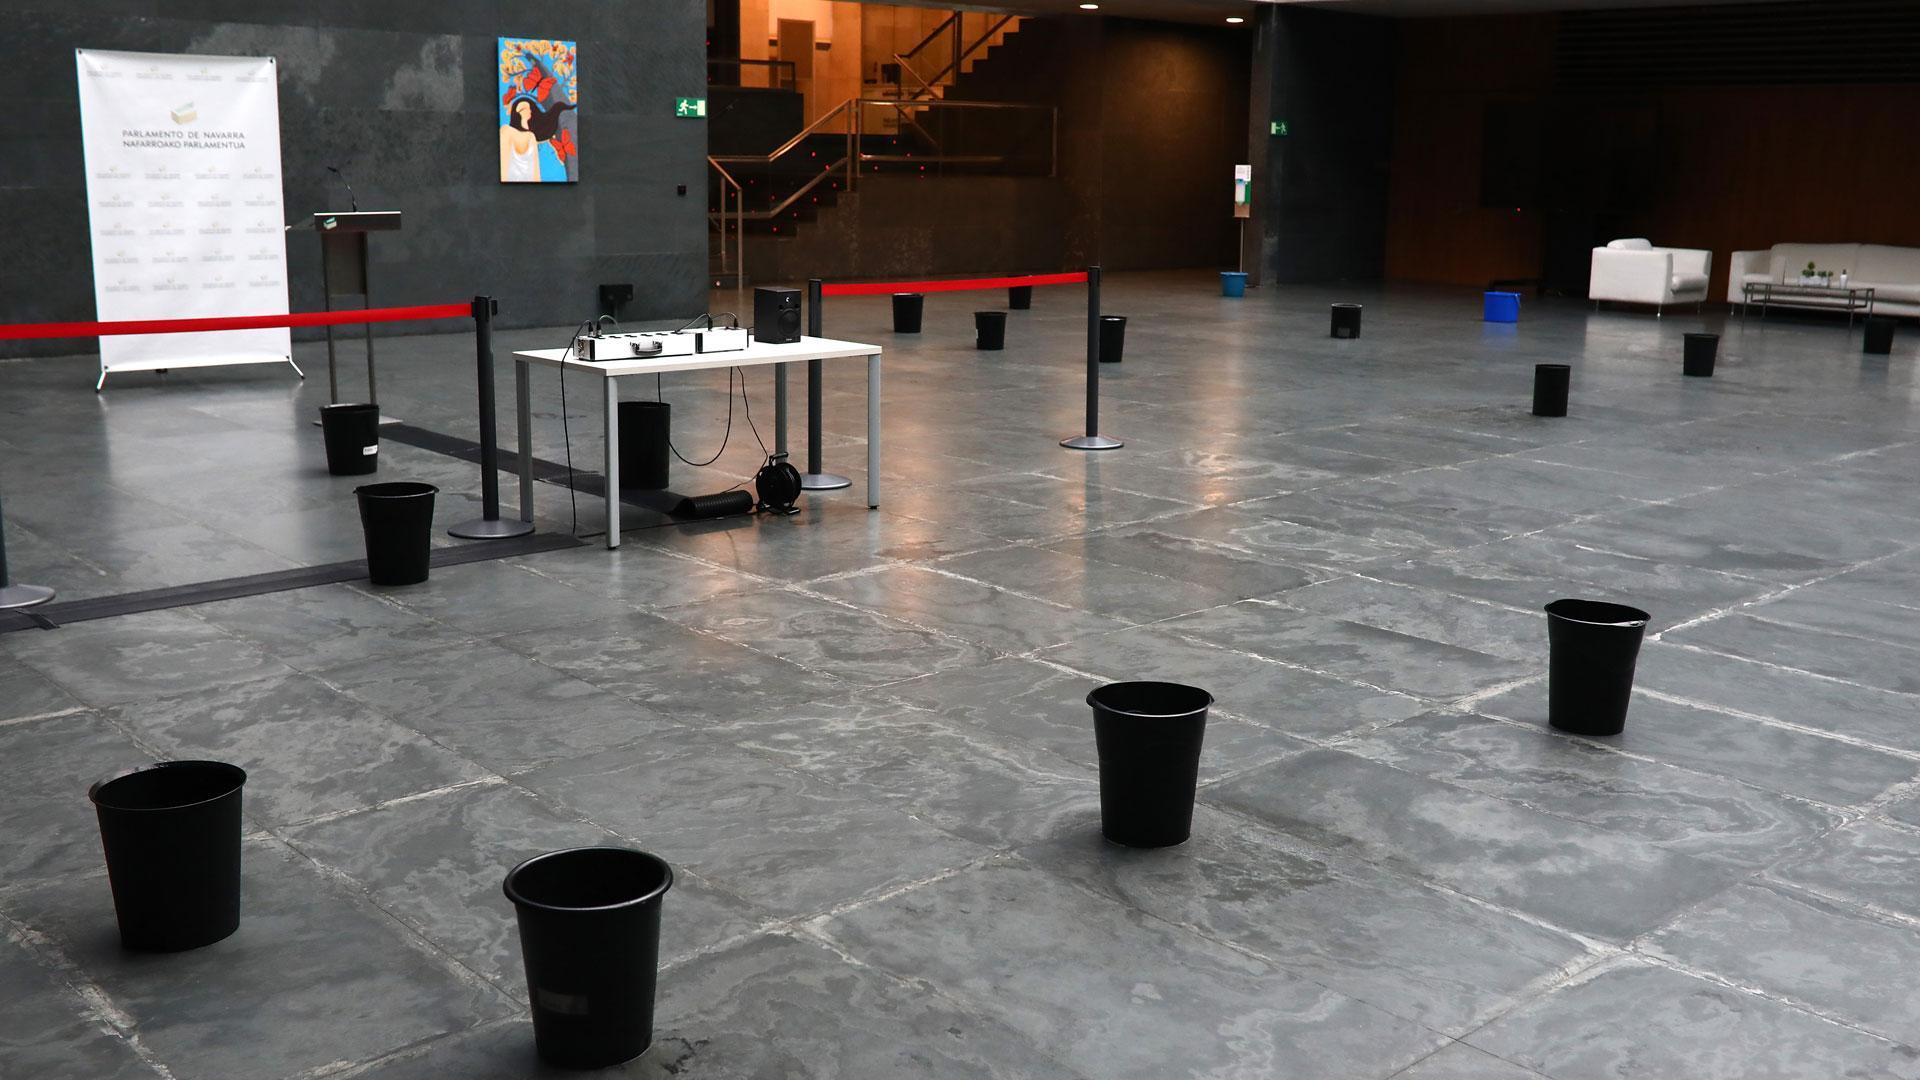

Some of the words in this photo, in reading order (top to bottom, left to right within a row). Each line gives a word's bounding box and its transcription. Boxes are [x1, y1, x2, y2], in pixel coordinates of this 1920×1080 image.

[122, 130, 184, 139] PARLAMENTO
[187, 131, 200, 139] DE
[122, 140, 182, 149] NAFARROAKO
[183, 141, 246, 149] PARLAMENTUA
